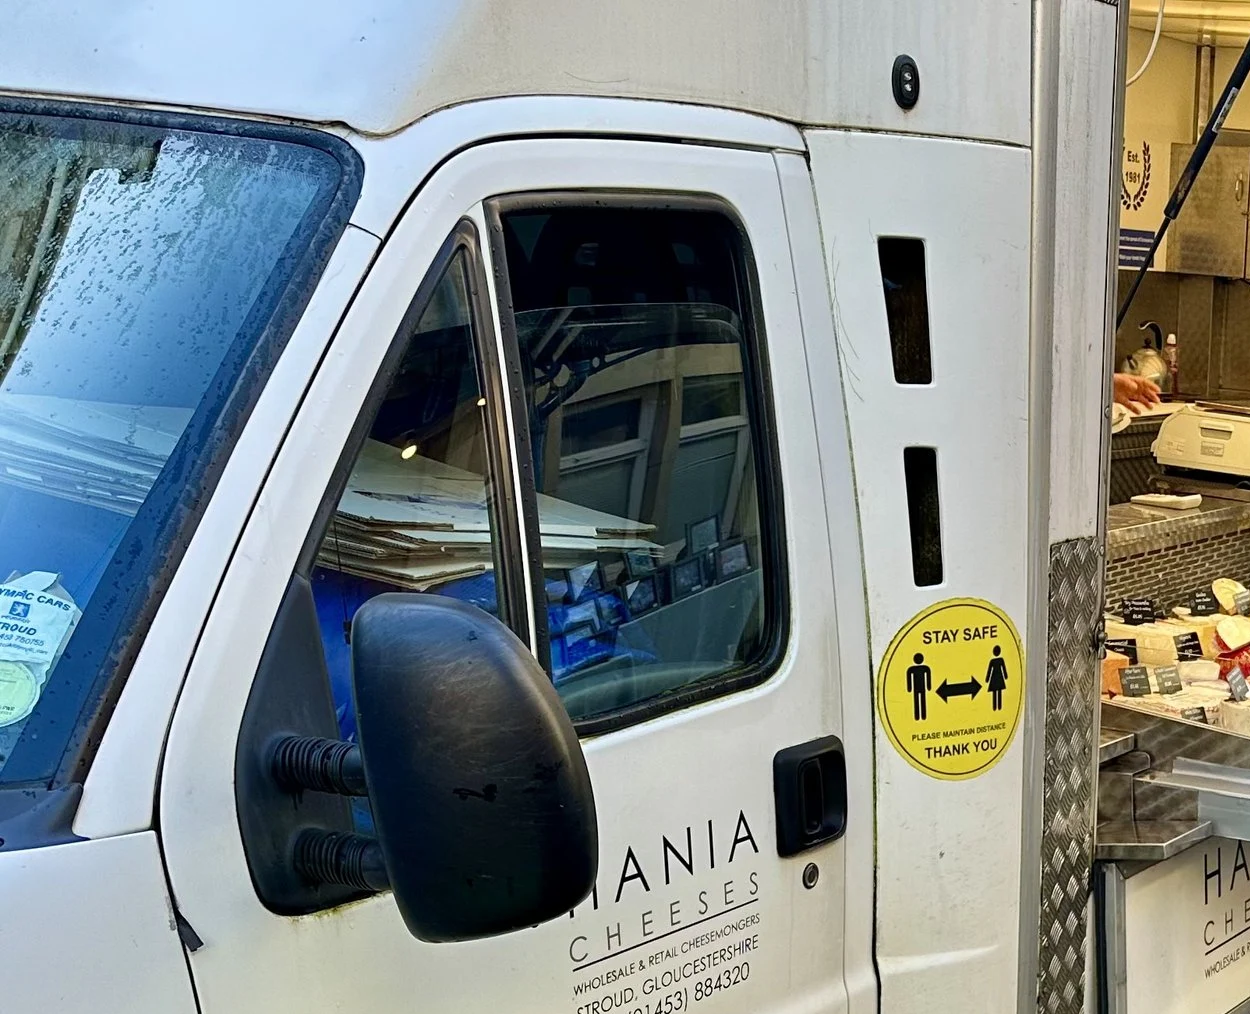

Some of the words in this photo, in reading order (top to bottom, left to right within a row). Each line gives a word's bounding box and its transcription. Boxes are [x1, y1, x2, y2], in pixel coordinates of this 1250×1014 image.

[1127, 151, 1140, 163] Est.
[1125, 171, 1141, 184] 1981
[0, 588, 34, 600] YMPIC
[37, 595, 71, 611] CARS
[0, 622, 37, 636] TROUD
[922, 629, 959, 644] STAY
[963, 625, 998, 641] SAFE
[912, 731, 941, 741] PLEASE
[942, 728, 975, 738] MAINTAIN
[976, 722, 1006, 734] DISTANCE
[925, 742, 970, 759] THANK
[973, 738, 997, 752] YOU
[569, 810, 759, 918] ANIA
[569, 872, 759, 963] CHEESES
[573, 966, 635, 996] WHOLESALE
[638, 959, 646, 972] &
[648, 946, 679, 967] RETAIL
[681, 913, 760, 954] CHEESEMONGERS
[642, 934, 759, 995] GLOUCESTERSHIRE
[1204, 948, 1240, 979] WHOLESALE
[1240, 946, 1246, 957] &
[694, 961, 750, 1001] 884320
